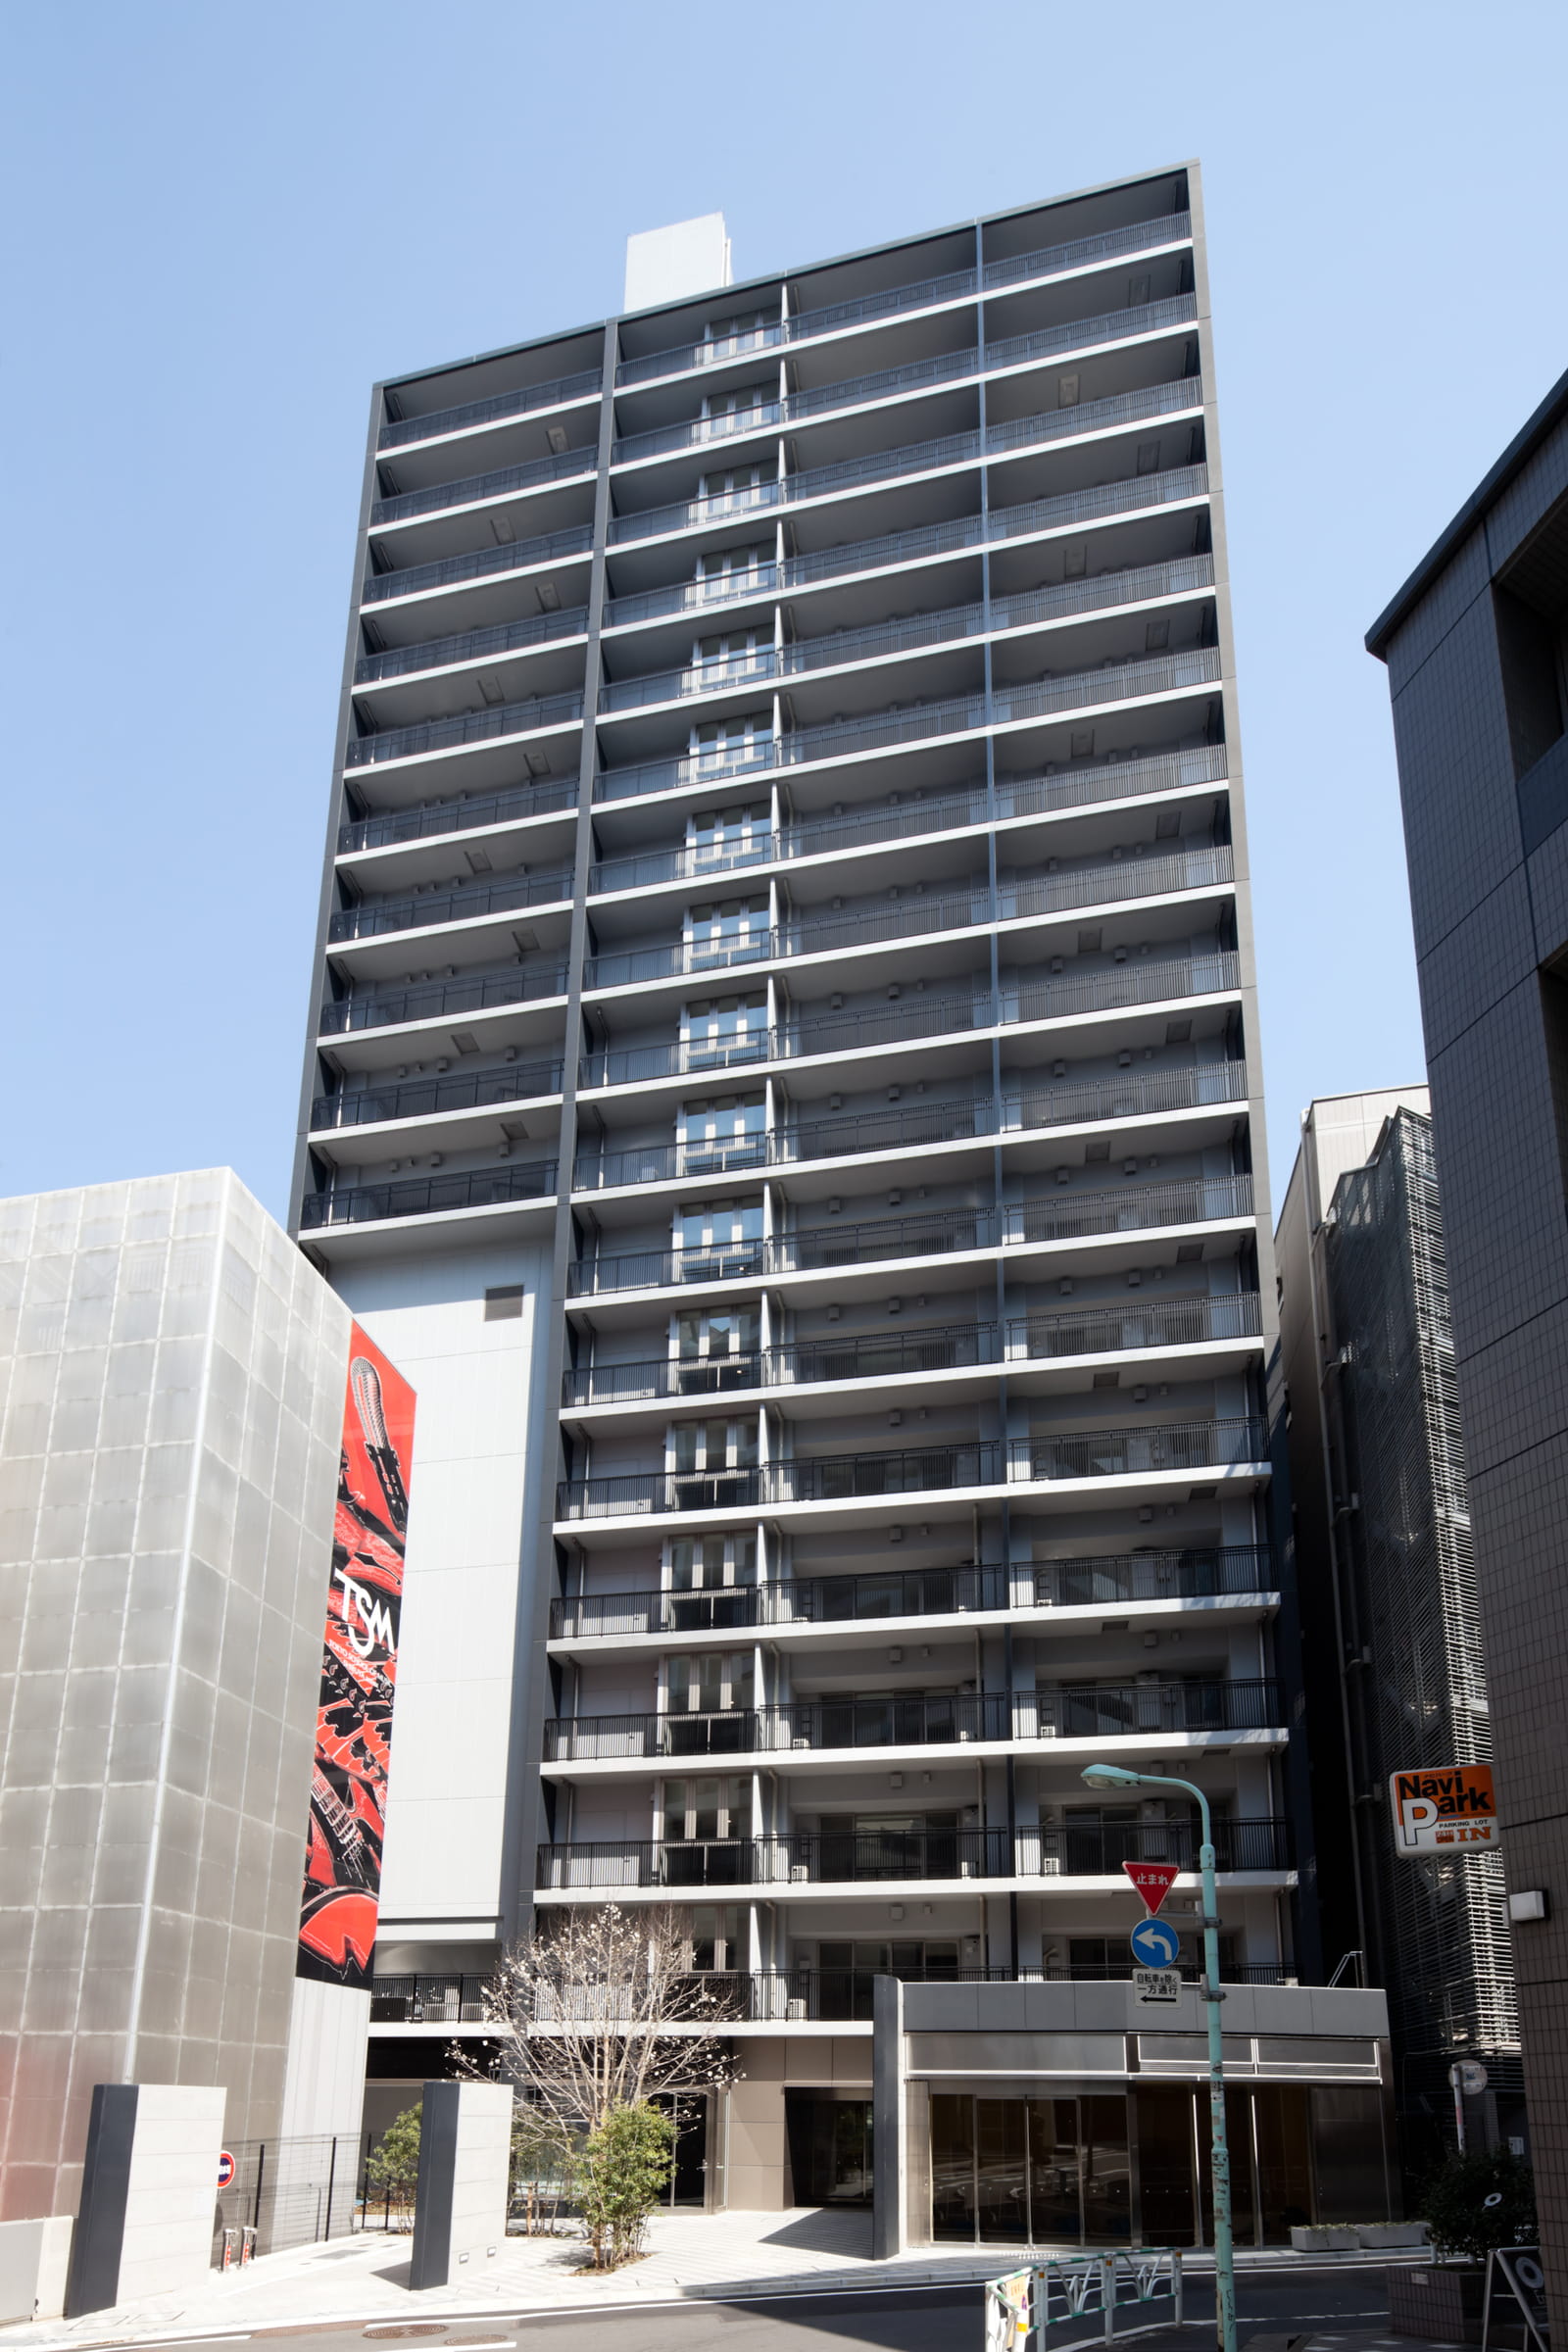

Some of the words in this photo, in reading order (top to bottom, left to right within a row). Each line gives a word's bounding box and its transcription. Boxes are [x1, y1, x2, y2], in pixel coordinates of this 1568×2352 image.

[334, 1567, 395, 1659] TSM
[1398, 1771, 1463, 1799] Navi
[1457, 1827, 1492, 1842] IN
[1136, 1873, 1169, 1886] 止まれ
[1137, 1973, 1177, 1984] 自転車を除く
[1137, 1984, 1178, 1995] 一方通行
